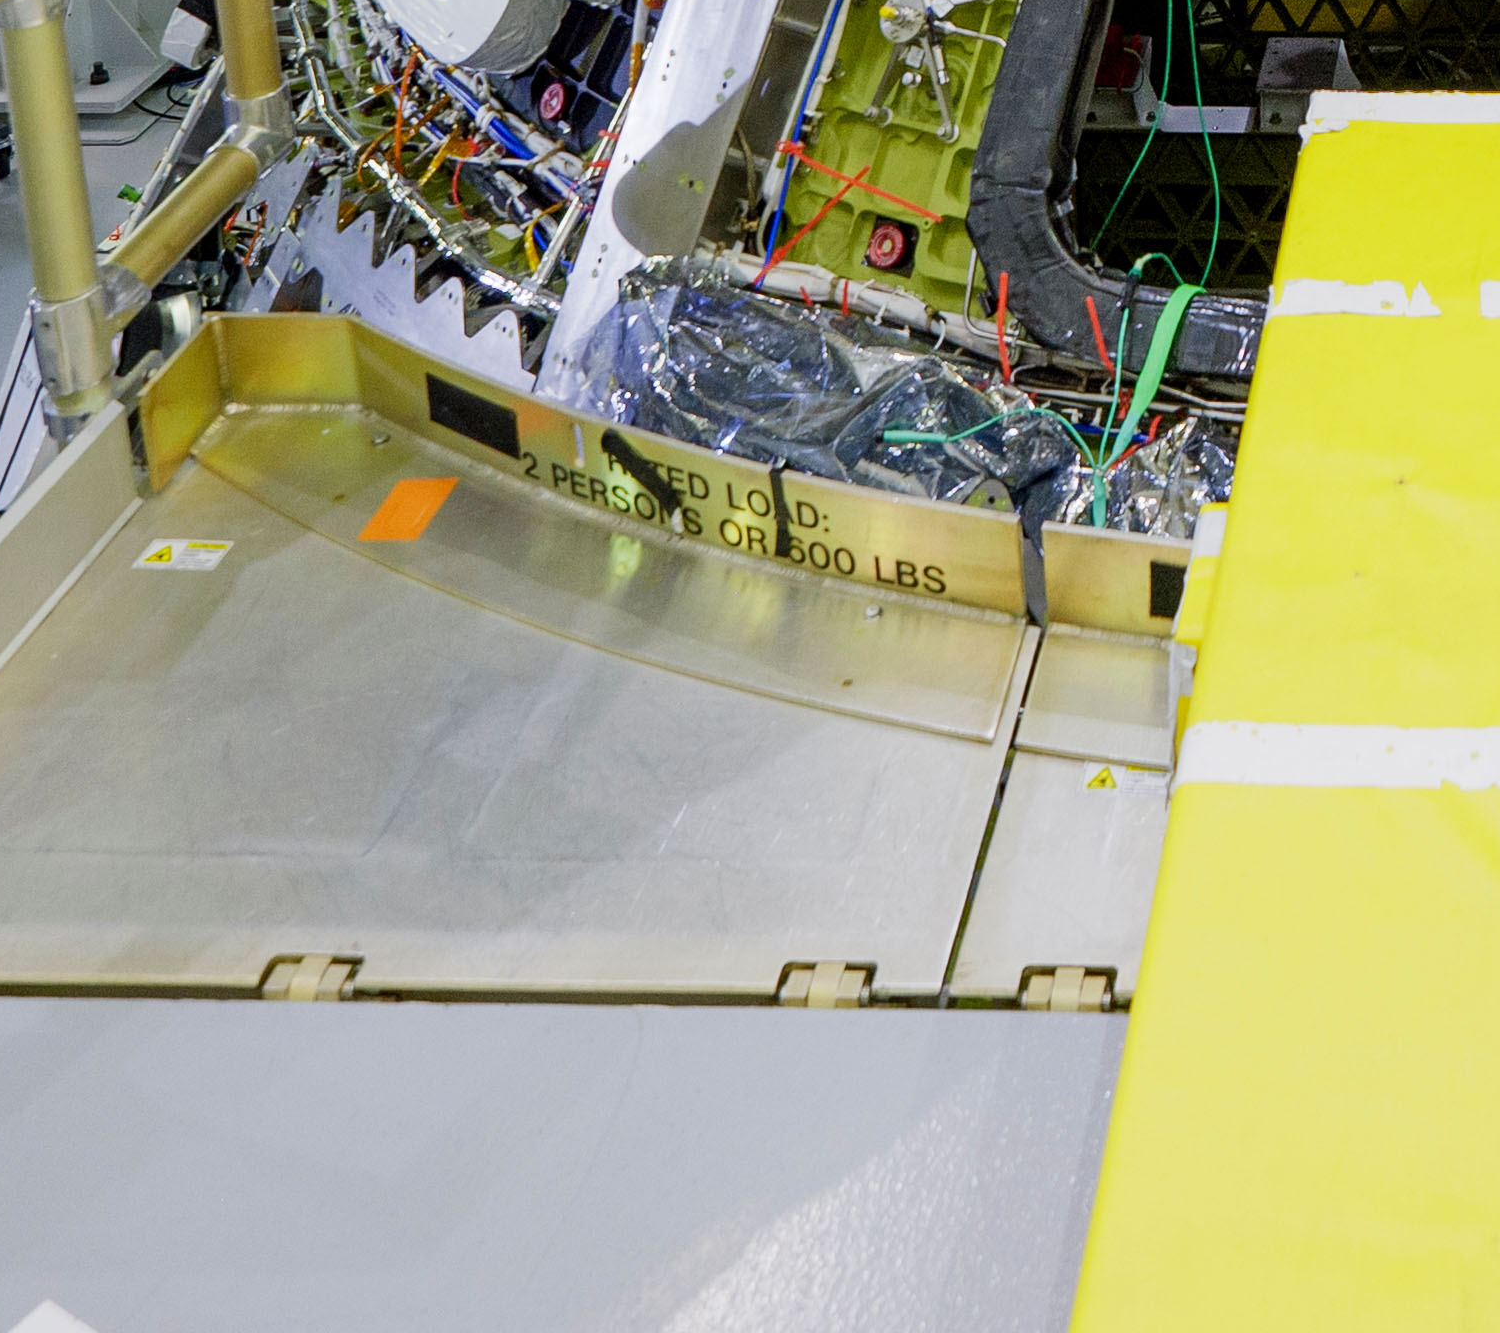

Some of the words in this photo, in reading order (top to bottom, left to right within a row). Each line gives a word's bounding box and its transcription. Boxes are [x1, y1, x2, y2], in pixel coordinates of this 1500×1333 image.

[522, 451, 542, 481] 2
[719, 518, 768, 556] OR
[874, 555, 948, 595] LBS
